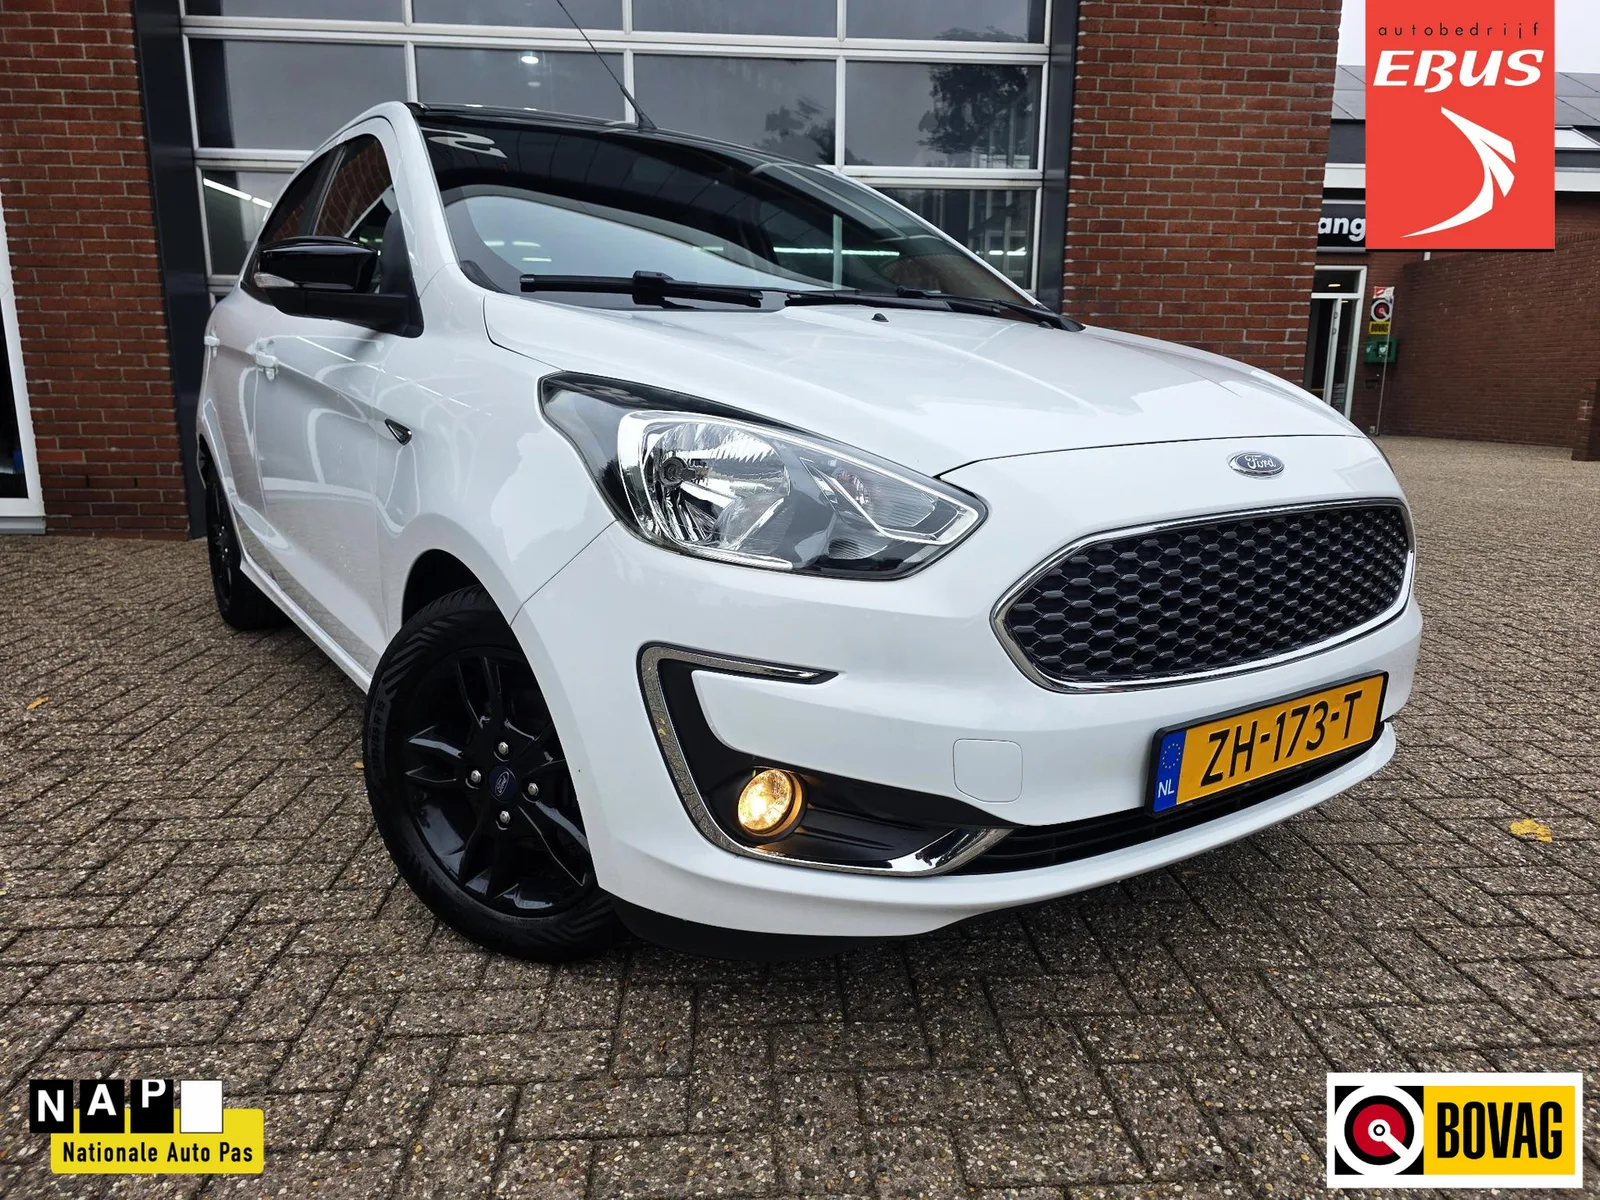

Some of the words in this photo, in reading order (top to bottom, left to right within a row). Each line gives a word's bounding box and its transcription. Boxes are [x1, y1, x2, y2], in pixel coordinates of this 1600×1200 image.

[1244, 454, 1277, 470] Ford
[1200, 690, 1362, 787] ZH-173-T
[1157, 780, 1175, 798] NL
